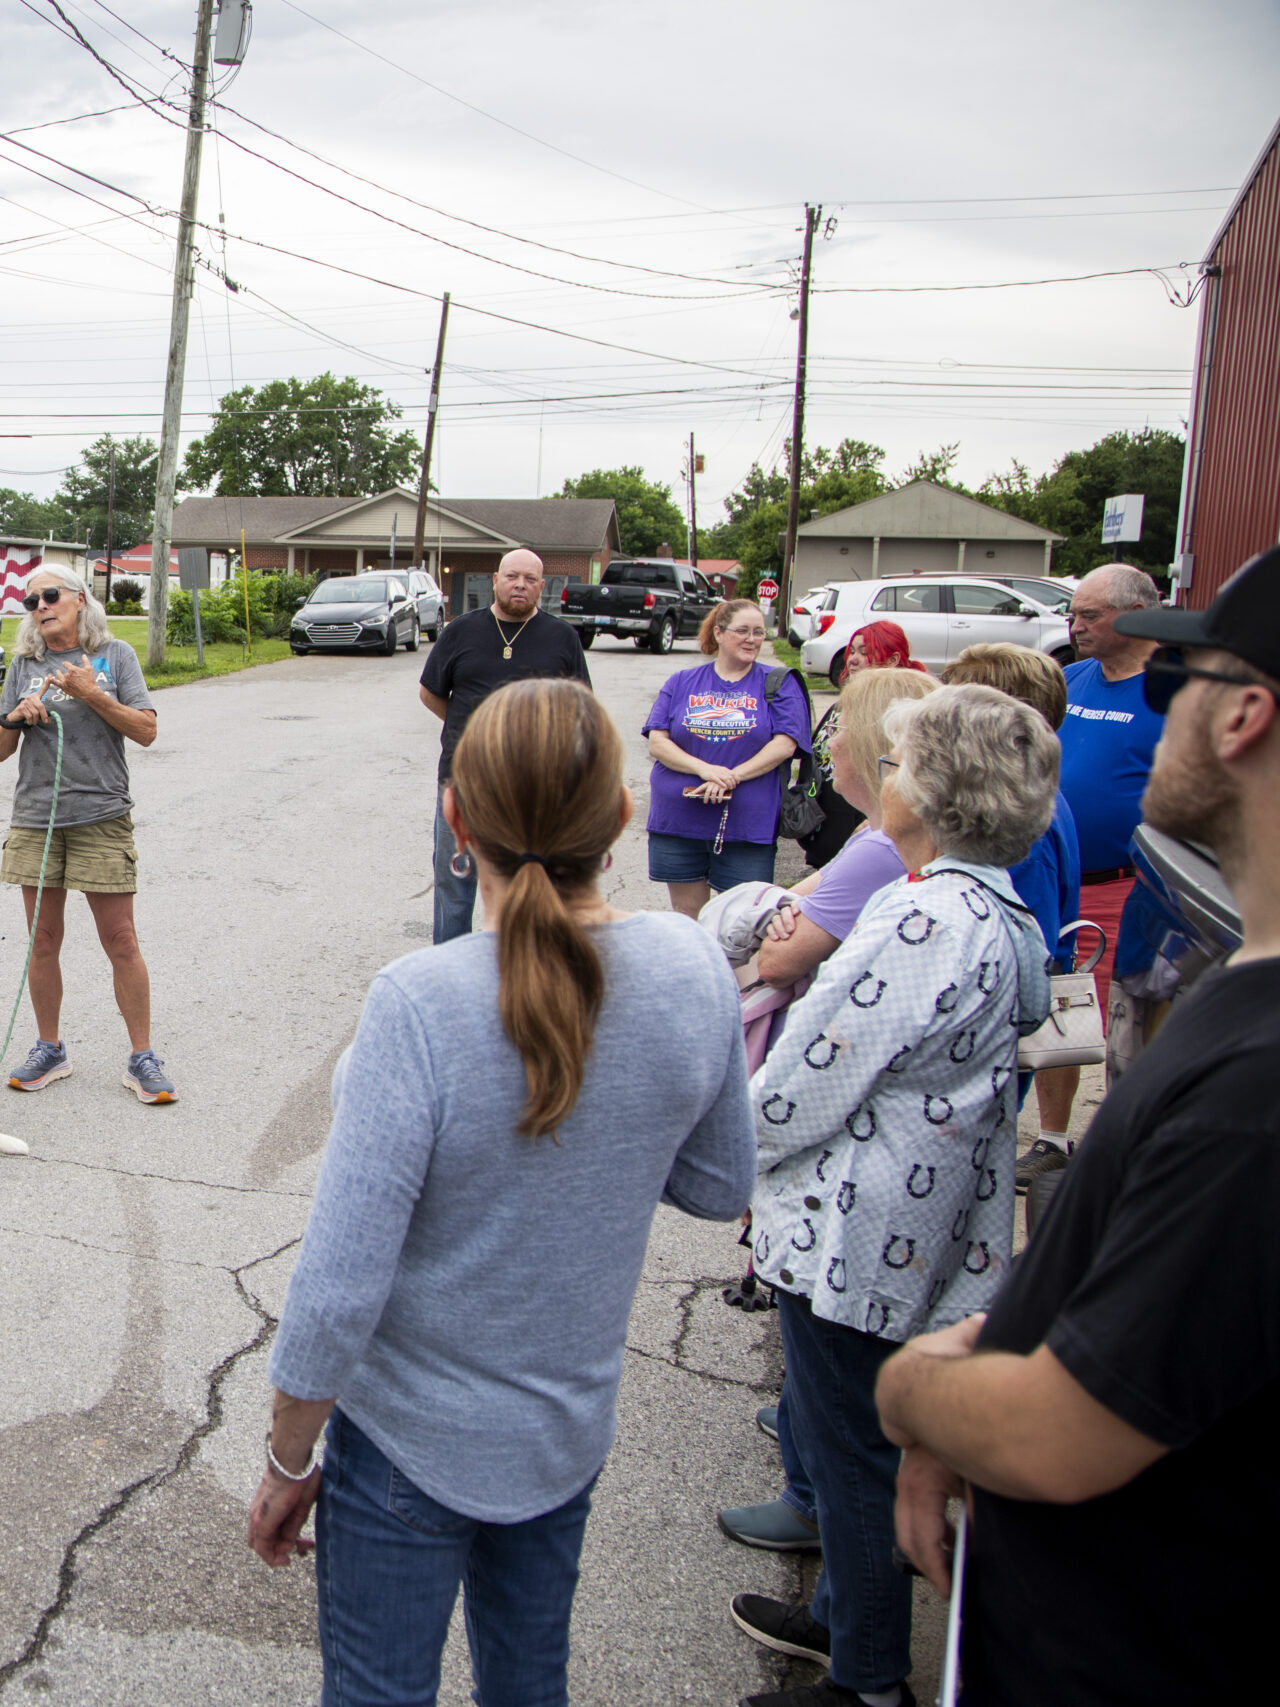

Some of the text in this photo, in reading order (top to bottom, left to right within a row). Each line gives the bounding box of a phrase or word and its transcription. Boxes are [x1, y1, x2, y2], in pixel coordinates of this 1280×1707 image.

[758, 586, 777, 596] STOP
[689, 694, 757, 711] WALKER
[1080, 708, 1106, 720] MERCER
[1104, 710, 1135, 723] COUNTY
[688, 719, 711, 727] JUDGE
[690, 727, 712, 735] MERCER
